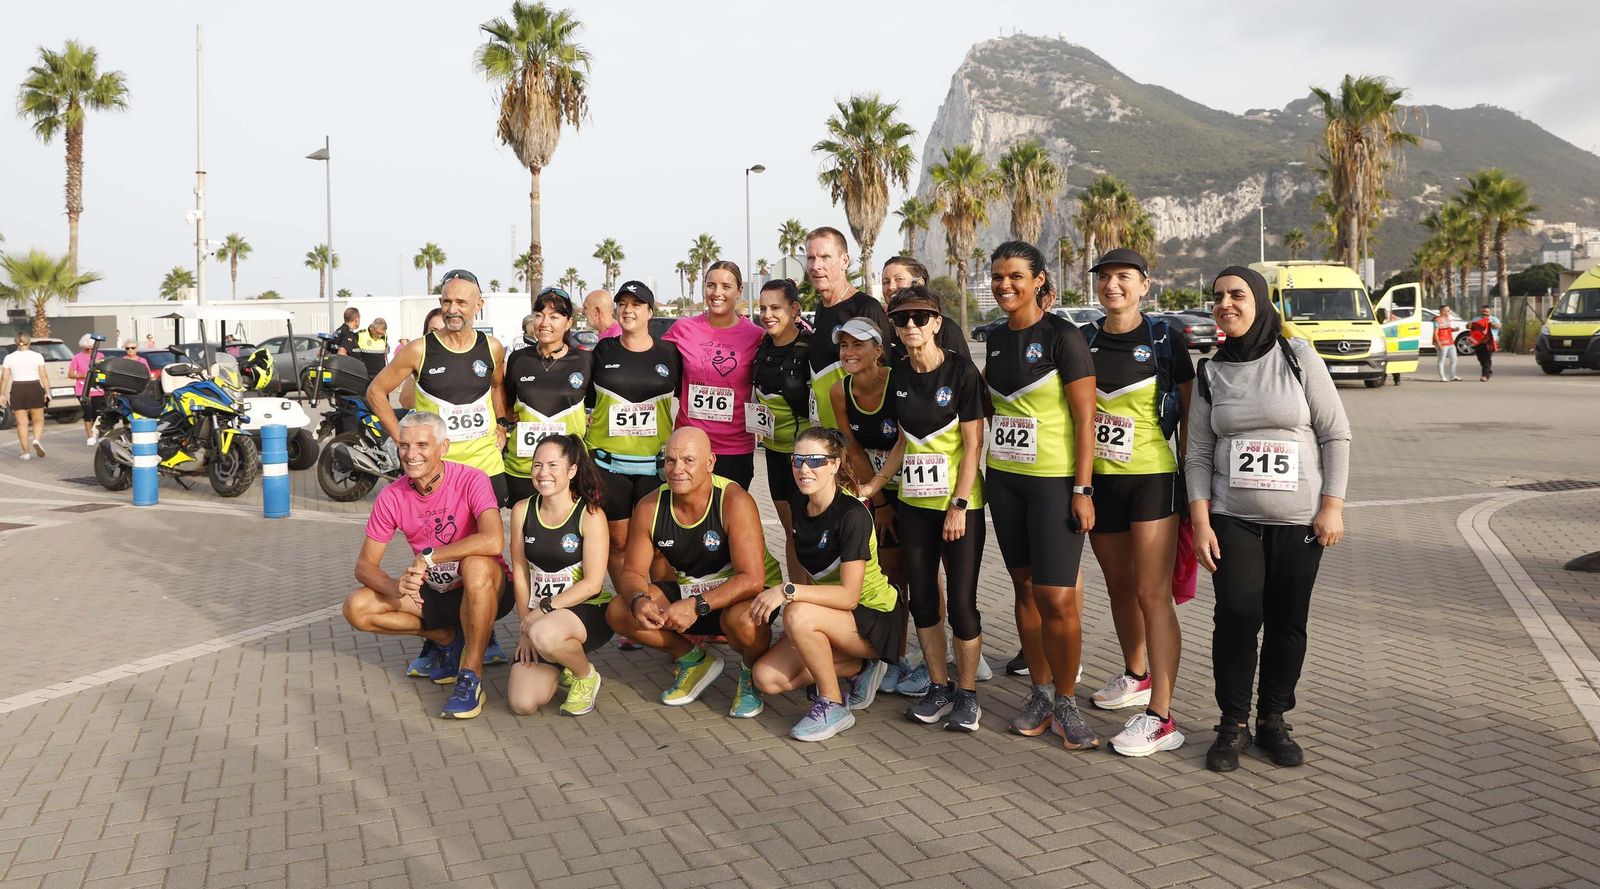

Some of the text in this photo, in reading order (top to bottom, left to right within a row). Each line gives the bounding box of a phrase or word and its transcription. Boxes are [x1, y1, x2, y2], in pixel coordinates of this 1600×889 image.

[693, 394, 727, 410] 516
[448, 413, 484, 430] 369
[616, 412, 650, 426] 517
[524, 432, 559, 446] 64
[995, 428, 1029, 447] 842
[1094, 425, 1125, 446] 82
[1239, 453, 1289, 474] 215
[904, 465, 938, 483] 111
[535, 582, 565, 598] 247
[1146, 728, 1165, 742] HOKA
